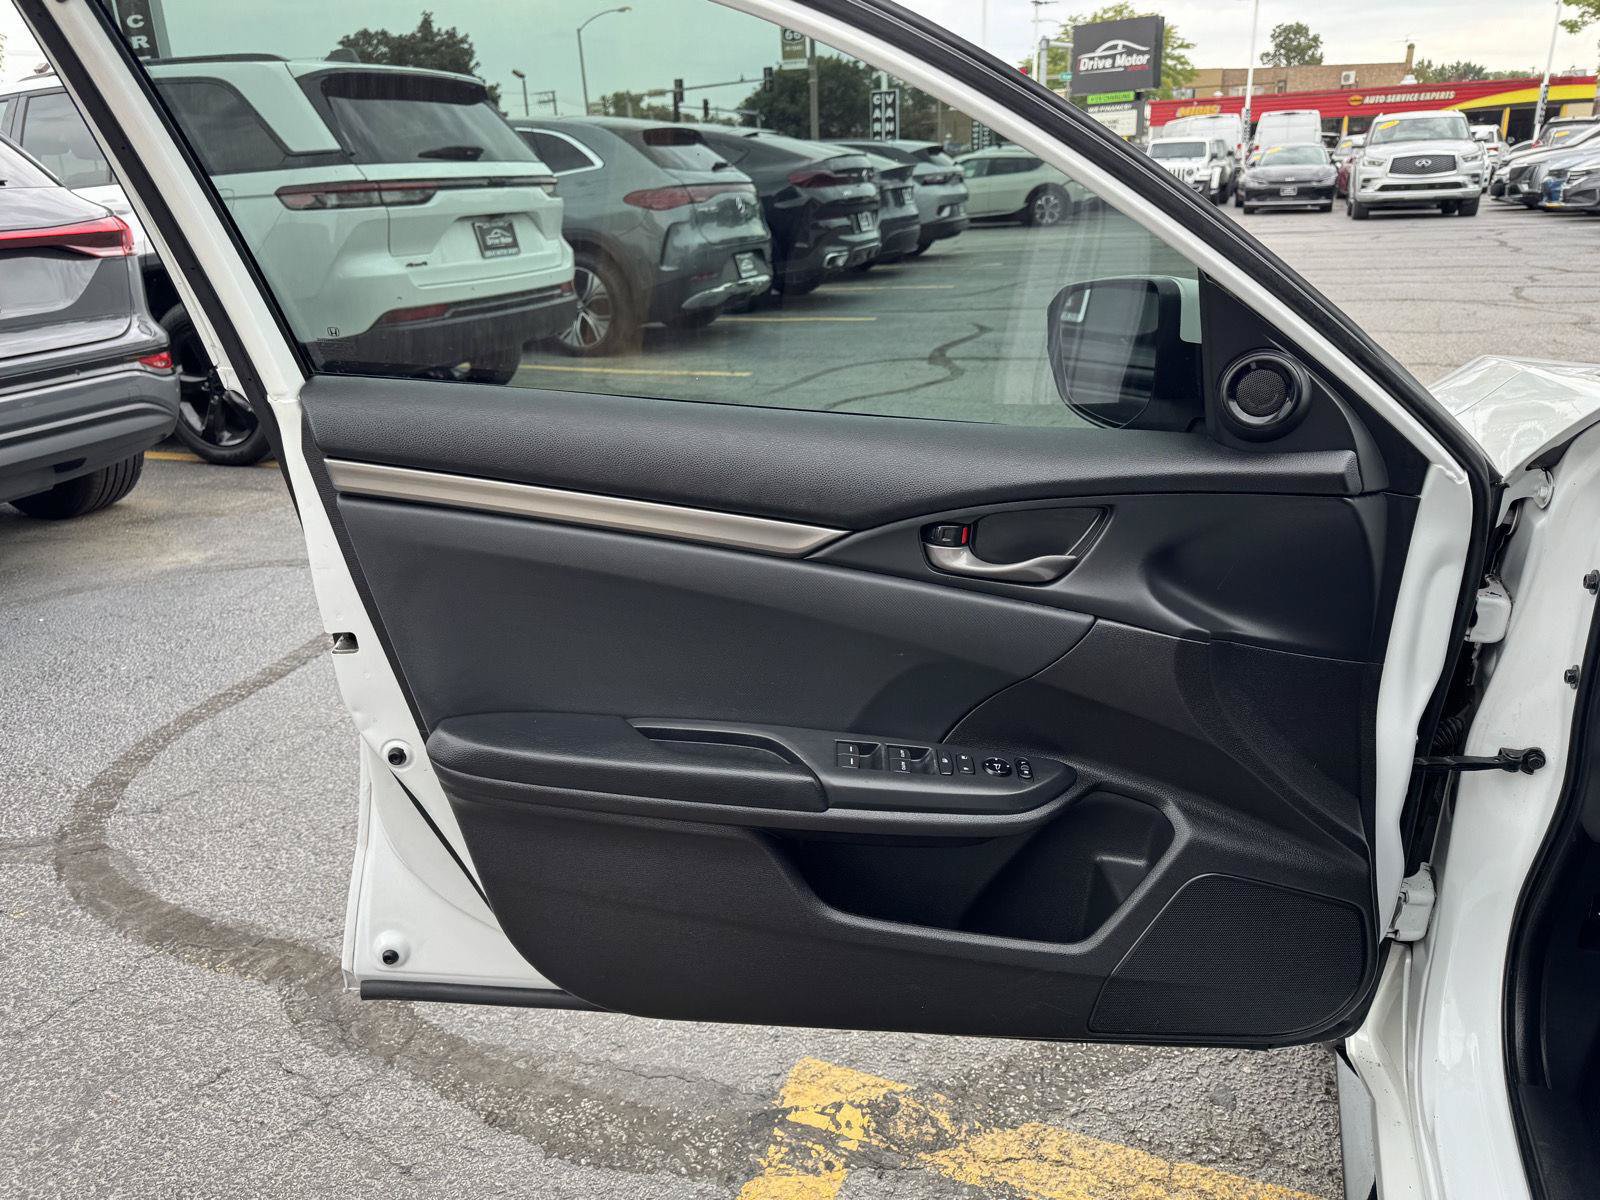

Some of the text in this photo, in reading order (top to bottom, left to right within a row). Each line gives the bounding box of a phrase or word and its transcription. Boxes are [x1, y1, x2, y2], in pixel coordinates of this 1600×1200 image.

[1079, 57, 1113, 71] Drive
[1114, 53, 1151, 67] Motor
[1363, 90, 1456, 104] AUTO SERVICE EXPERTS
